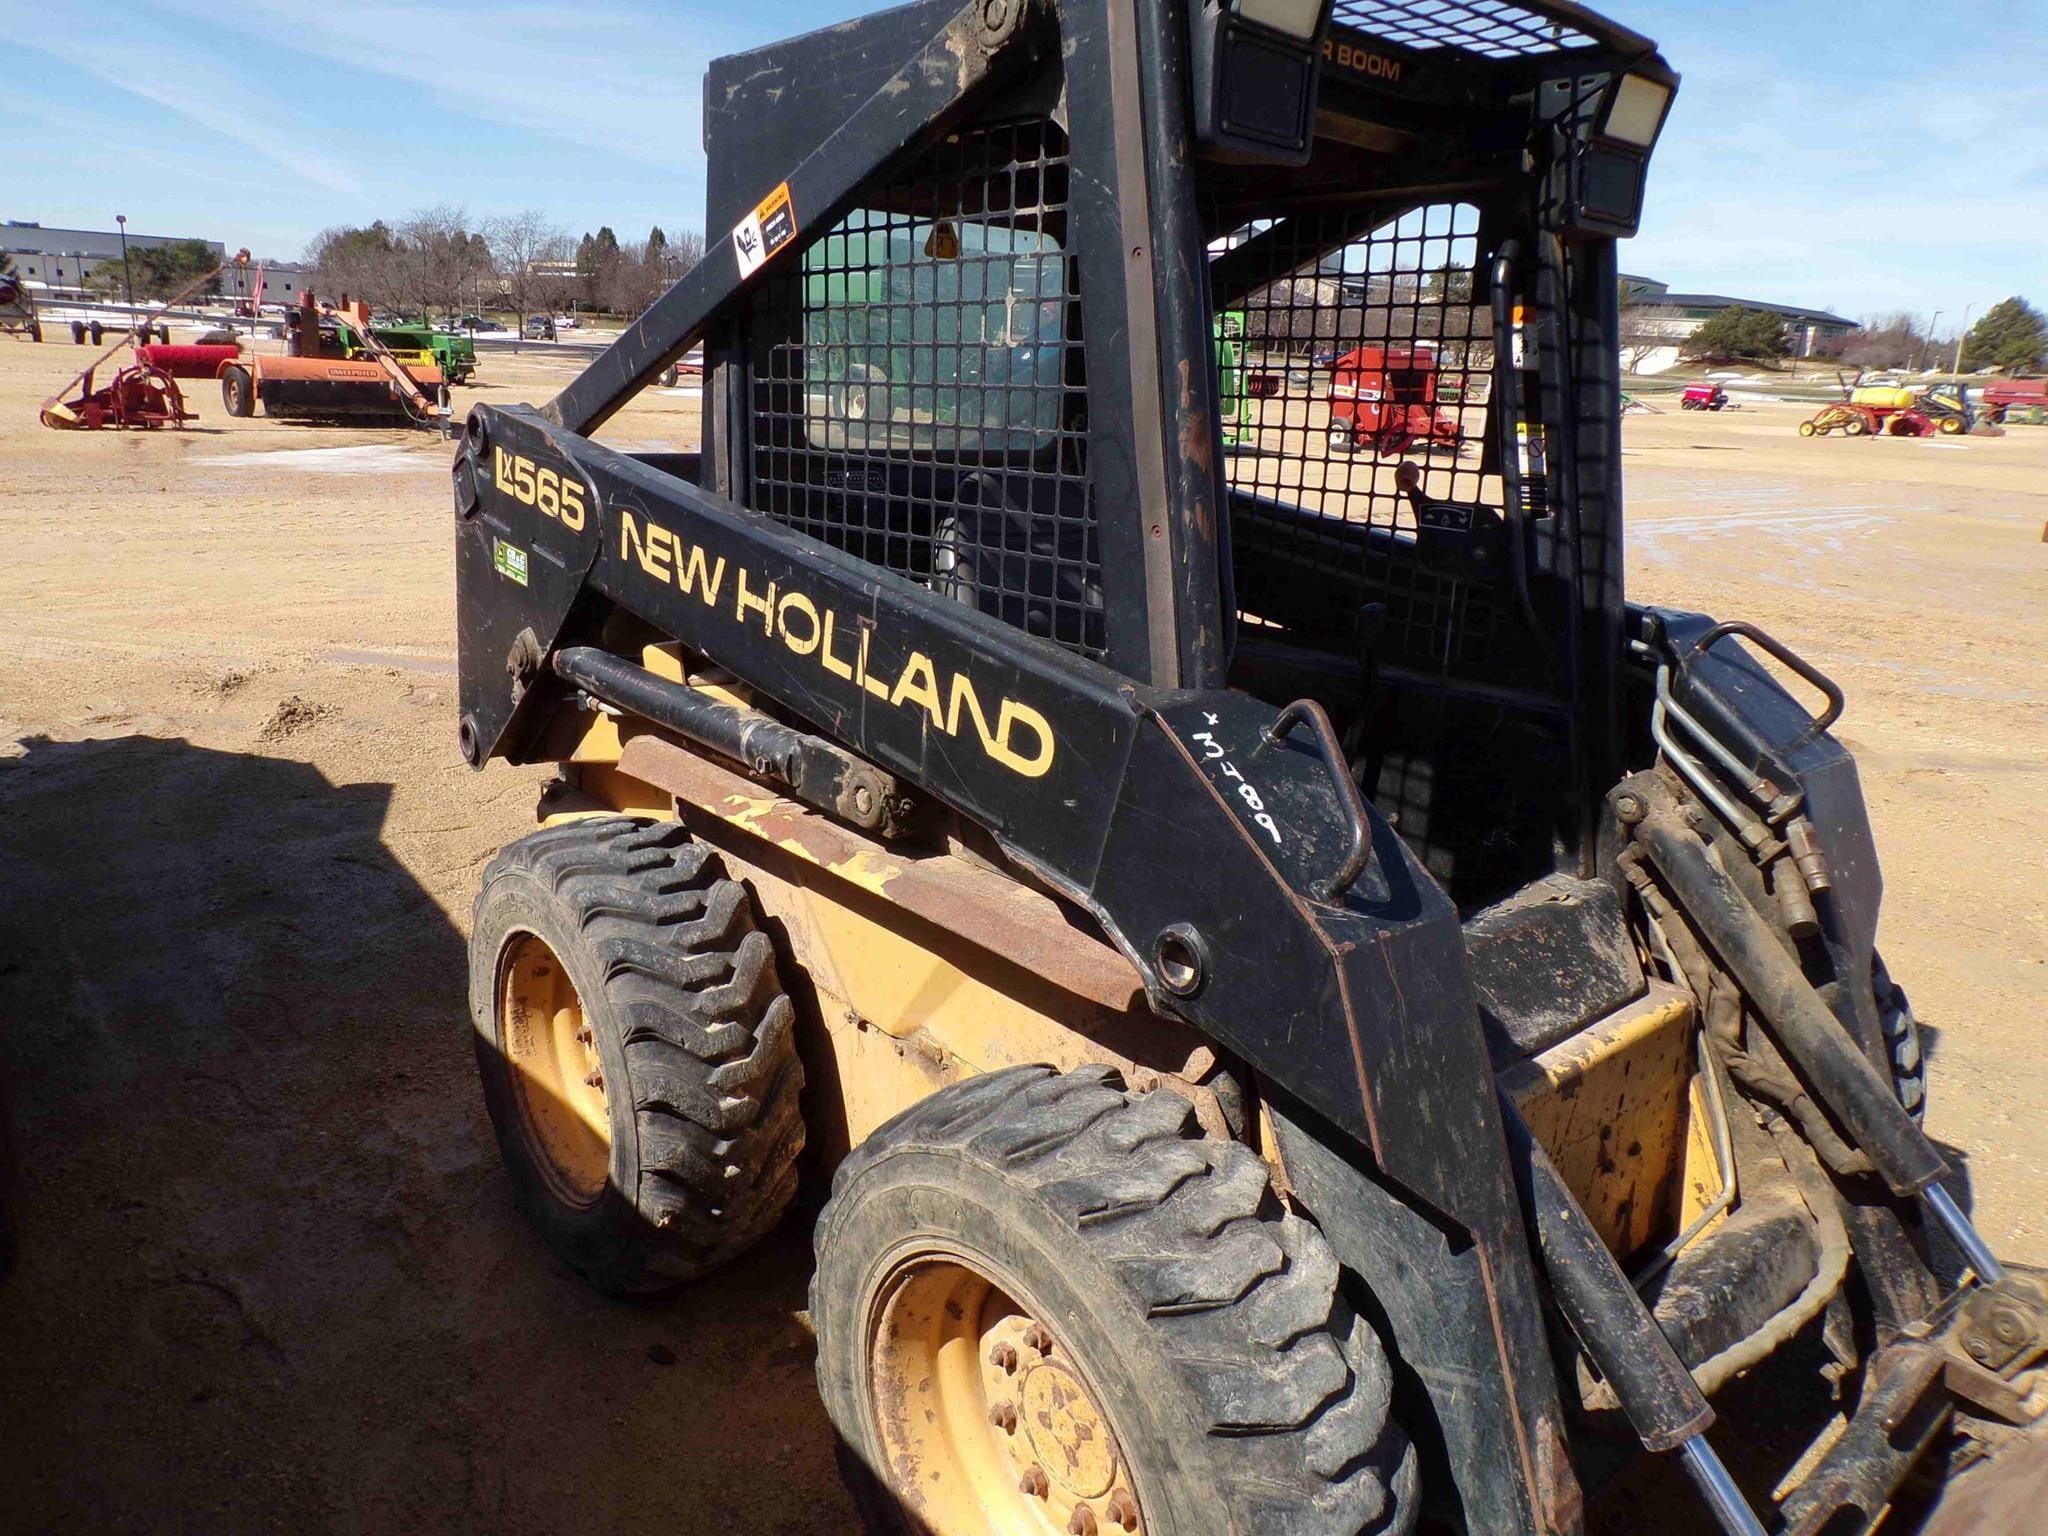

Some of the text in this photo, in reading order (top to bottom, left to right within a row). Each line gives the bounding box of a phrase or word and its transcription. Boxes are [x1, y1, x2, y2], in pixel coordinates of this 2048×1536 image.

[1337, 44, 1401, 82] BOOM
[495, 445, 585, 532] LX565
[621, 511, 1056, 778] NEW HOLLAND
